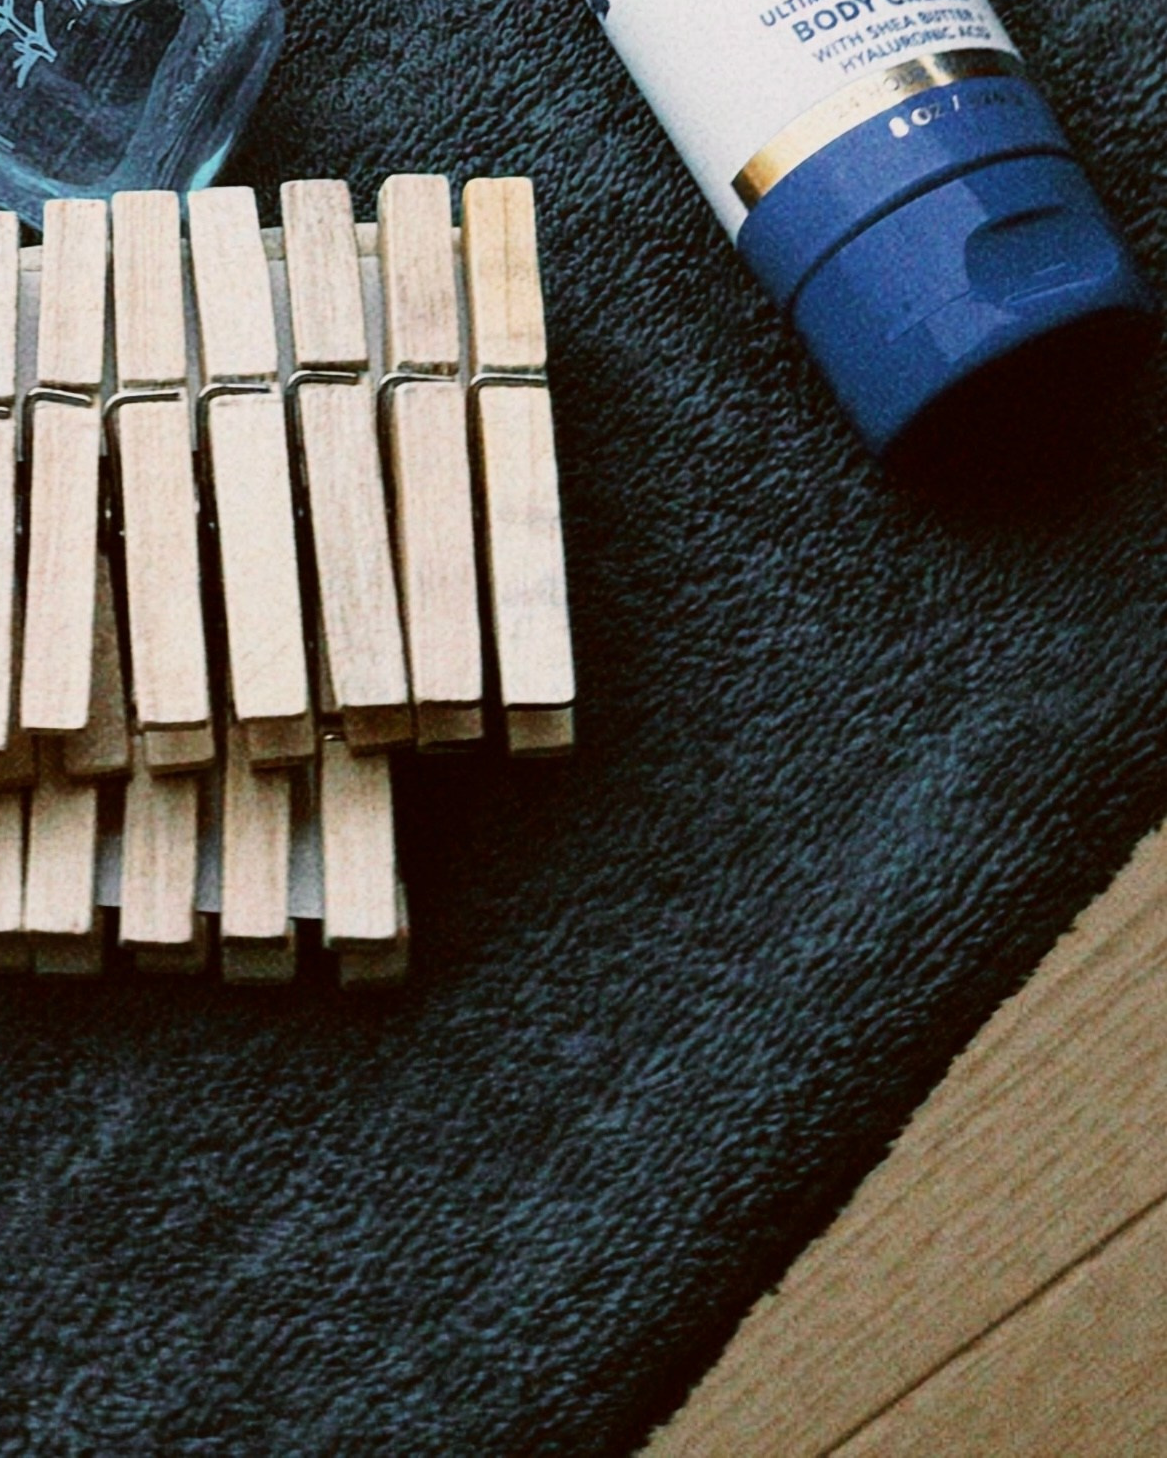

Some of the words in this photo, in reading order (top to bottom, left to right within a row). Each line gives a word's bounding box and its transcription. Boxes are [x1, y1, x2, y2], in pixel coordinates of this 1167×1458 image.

[813, 31, 864, 63] WITH
[866, 15, 915, 40] SHEA
[917, 8, 976, 25] BUTTER
[840, 26, 956, 74] HYALURONIC
[958, 24, 991, 41] ACID
